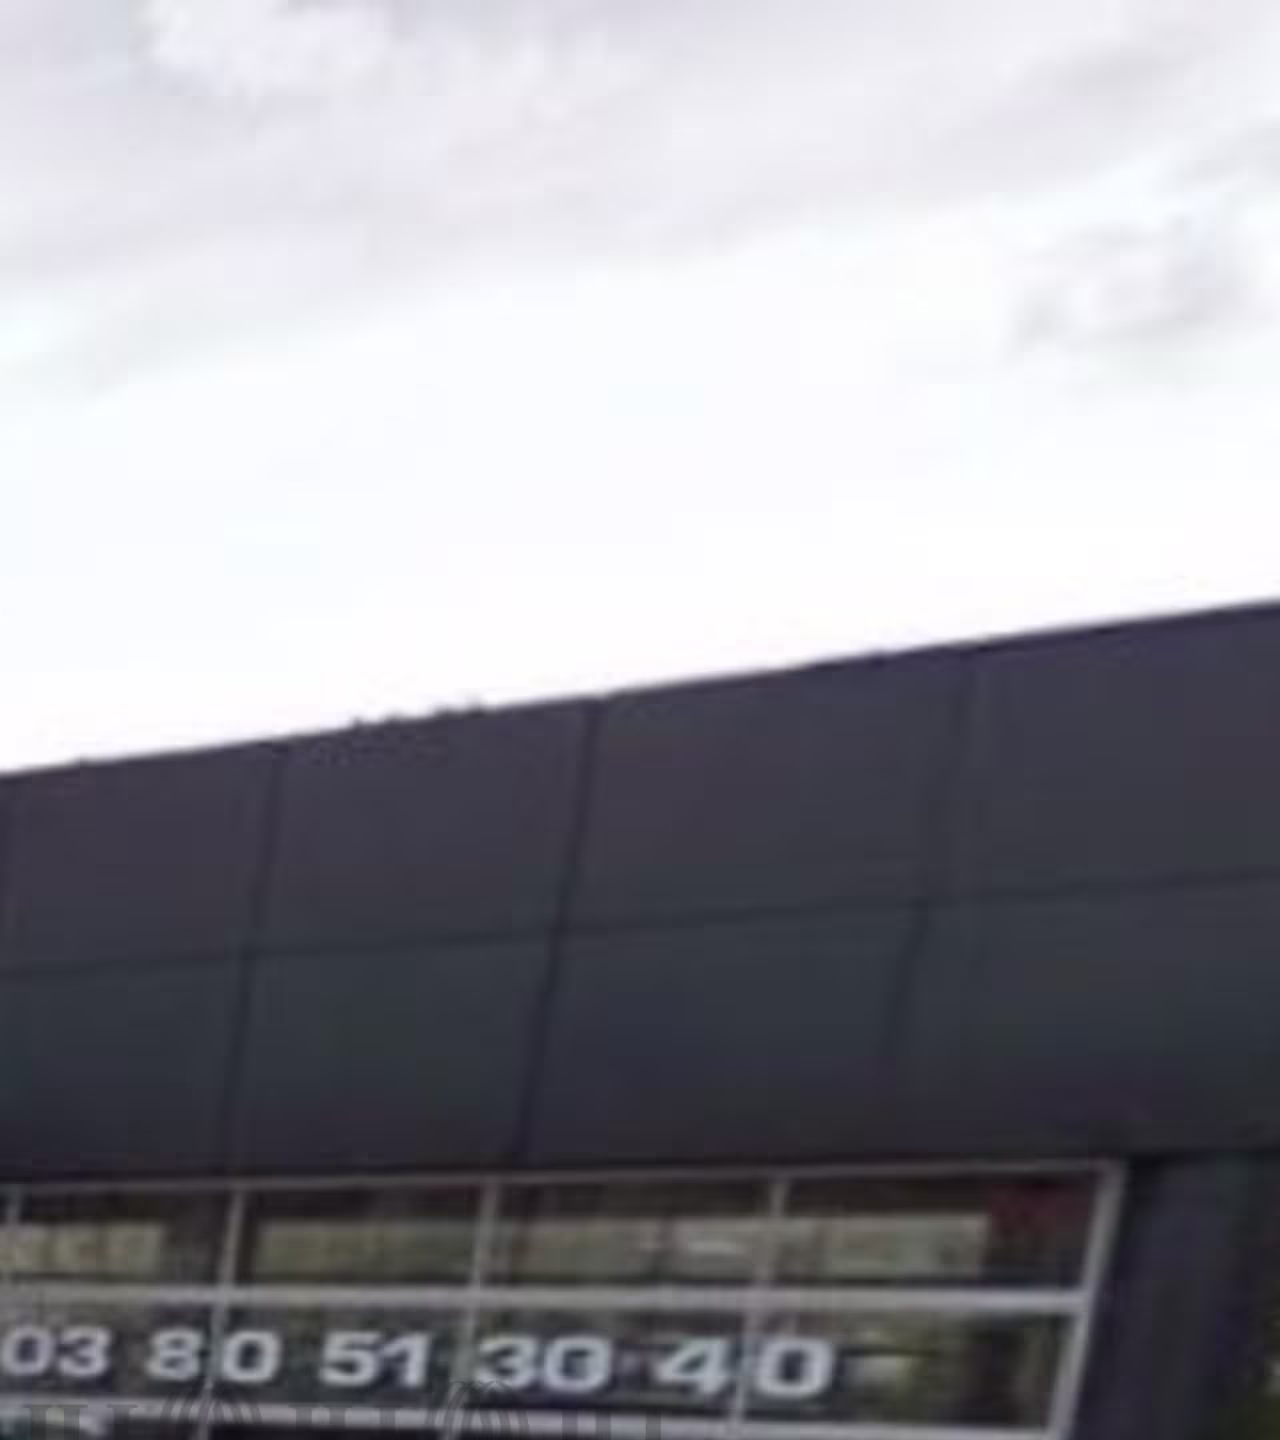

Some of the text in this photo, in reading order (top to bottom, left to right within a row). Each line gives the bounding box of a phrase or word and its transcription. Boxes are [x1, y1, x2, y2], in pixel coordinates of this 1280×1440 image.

[2, 1324, 112, 1380] 03
[146, 1328, 282, 1386] 80
[320, 1330, 434, 1390] 51
[474, 1332, 612, 1394] 30
[654, 1336, 836, 1398] 40
